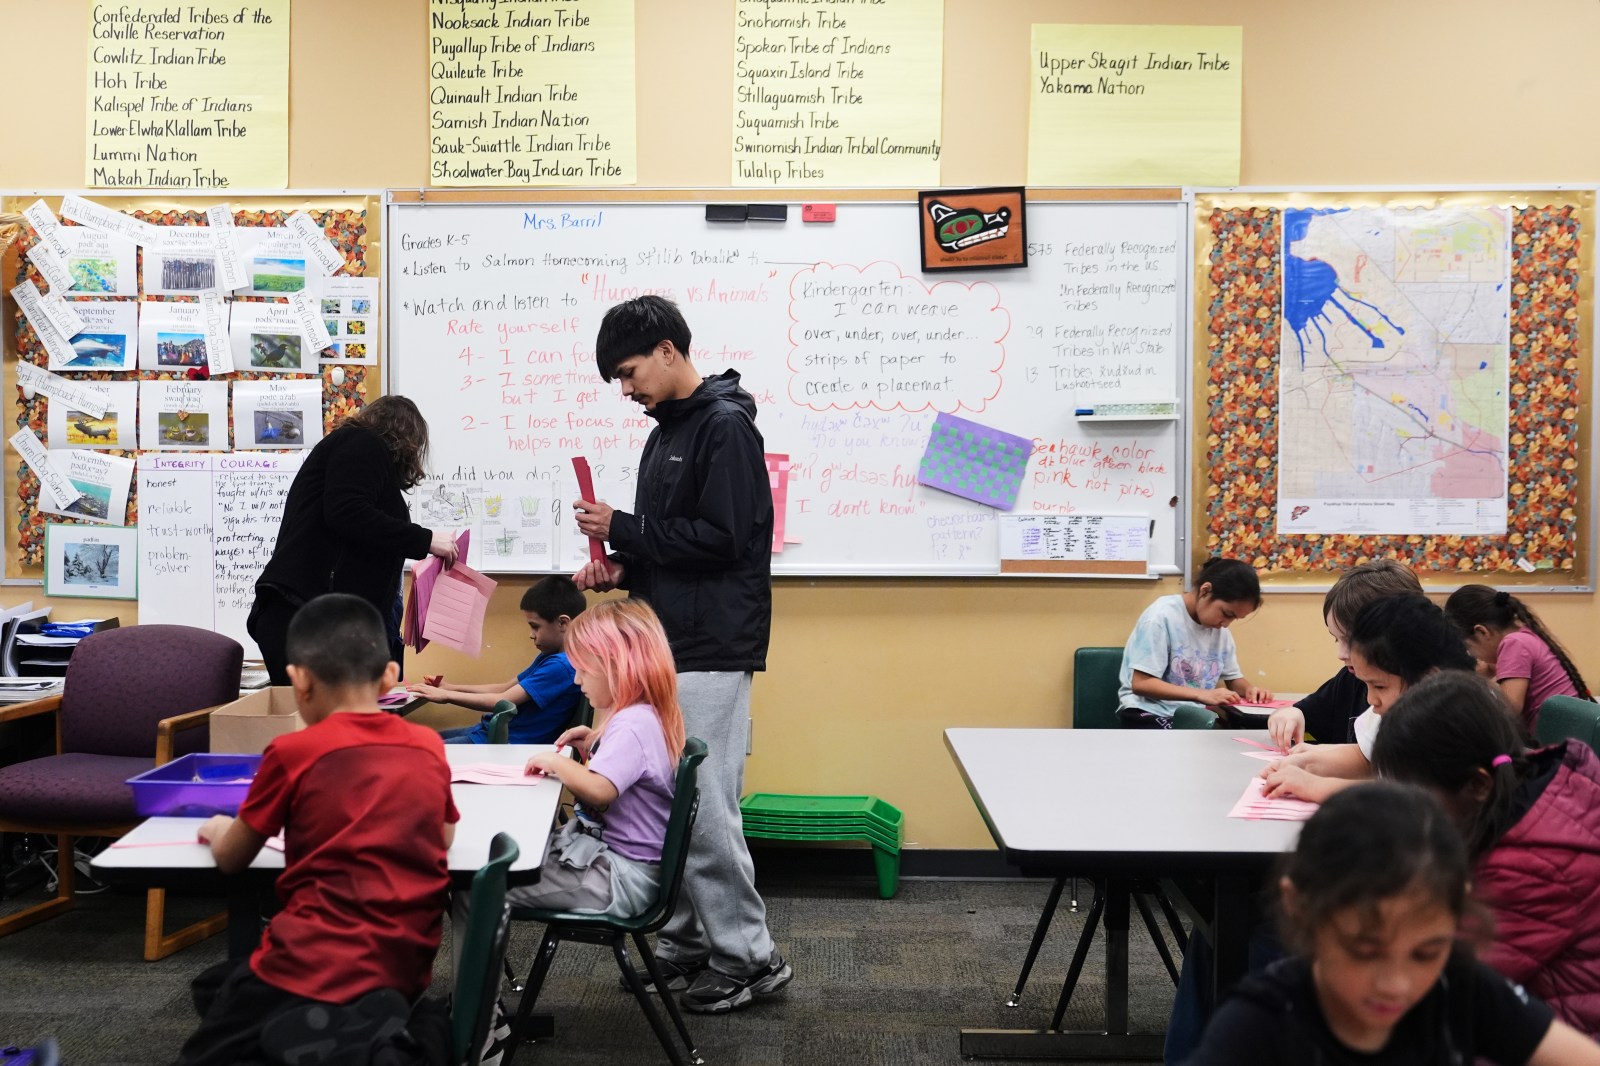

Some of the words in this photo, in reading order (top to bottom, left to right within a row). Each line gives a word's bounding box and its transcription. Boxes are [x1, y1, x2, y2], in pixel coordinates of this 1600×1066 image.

[94, 5, 180, 24] Confederated
[188, 7, 228, 24] Tribes
[233, 7, 248, 23] of
[252, 7, 272, 24] the
[433, 12, 499, 29] Nooksack
[504, 11, 551, 28] Indian
[555, 10, 590, 27] Tribe
[738, 11, 810, 28] Snohomish
[817, 11, 846, 28] Tribe
[93, 22, 138, 39] Colville
[144, 23, 225, 40] Reservation
[94, 46, 146, 64] Cowlitz
[149, 47, 194, 65] Indian
[195, 48, 226, 64] Tribe
[433, 37, 487, 61] Puyallup
[490, 36, 520, 53] Tribe
[525, 36, 539, 51] of
[542, 35, 595, 52] Indians
[737, 36, 786, 60] Spokan
[789, 36, 819, 54] Tribe
[823, 37, 839, 54] of
[841, 36, 891, 54] Indians
[431, 62, 486, 79] Quileute
[492, 60, 523, 77] Tribe
[737, 61, 788, 84] Squaxin
[790, 61, 831, 79] Island
[837, 61, 864, 79] Tribe
[1040, 51, 1085, 76] Upper
[1089, 51, 1138, 76] Skagit
[1144, 53, 1192, 70] Indian
[1197, 53, 1230, 70] Tribe
[94, 71, 126, 89] Hoh
[133, 72, 167, 89] Tribe
[1040, 76, 1093, 94] Yakama
[1098, 77, 1145, 95] Nation
[431, 86, 491, 104] Quinault
[495, 85, 541, 103] Indian
[545, 84, 577, 101] Tribe
[738, 85, 825, 110] Stillaguamish
[831, 87, 862, 104] Tribe
[94, 96, 144, 117] Kalispel
[150, 96, 178, 112] Tribe
[182, 98, 197, 111] of
[201, 97, 252, 112] Indians
[214, 119, 246, 137] Tribe
[432, 111, 486, 129] Samish
[492, 111, 538, 128] Indian
[541, 110, 589, 127] Nation
[737, 110, 804, 135] Suquamish
[809, 111, 839, 129] Tribe
[432, 136, 521, 153] Sauk-Suiattle
[526, 134, 573, 152] Indian
[576, 133, 611, 151] Tribe
[735, 136, 801, 154] Swinomish
[804, 137, 842, 154] Indian
[845, 137, 879, 154] Tribal
[881, 137, 941, 161] Community
[93, 144, 141, 161] Lummi
[147, 144, 197, 162] Nation
[94, 167, 142, 186] Makah
[147, 168, 190, 186] Indian
[193, 168, 229, 187] Tribe
[432, 161, 503, 178] Shoalwater
[504, 160, 530, 183] Bay
[532, 159, 583, 177] Indian
[586, 158, 621, 176] Tribe
[736, 160, 781, 184] Tulalip
[785, 161, 824, 178] Tribes
[523, 213, 556, 230] Mrs.
[561, 212, 602, 228] Barril
[80, 232, 108, 240] August
[170, 230, 209, 238] December
[402, 233, 441, 251] Grades
[1065, 243, 1115, 261] Federally
[455, 257, 470, 271] to
[482, 255, 534, 268] Salmon
[542, 253, 628, 274] Homecoming
[1064, 262, 1098, 275] Tribes
[1105, 262, 1117, 272] in
[1120, 260, 1139, 271] the
[168, 306, 199, 316] January
[472, 294, 507, 312] and
[514, 295, 550, 309] listen
[561, 293, 578, 306] to
[834, 303, 846, 317] I
[862, 303, 898, 314] can
[908, 304, 959, 316] weave
[73, 307, 115, 317] September
[267, 308, 288, 316] April
[447, 319, 485, 336] Rate
[498, 317, 580, 344] yourself
[846, 328, 883, 343] under,
[891, 331, 920, 343] over,
[499, 349, 515, 365] I
[527, 350, 562, 364] can
[717, 345, 757, 361] time
[805, 354, 848, 370] strips
[855, 351, 871, 365] of
[881, 354, 925, 373] paper
[940, 352, 956, 365] to
[499, 373, 518, 388] I
[806, 378, 854, 396] create
[861, 381, 869, 390] a
[166, 385, 201, 395] February
[502, 389, 538, 405] but
[553, 389, 567, 402] I
[576, 390, 601, 409] get
[501, 415, 517, 430] I
[529, 414, 557, 429] lose
[567, 413, 613, 430] focus
[623, 413, 649, 429] and
[508, 434, 551, 455] helps
[559, 437, 583, 449] me
[593, 435, 621, 459] get
[1111, 440, 1156, 459] color
[71, 452, 112, 468] November
[153, 458, 205, 468] INTEGRITY
[221, 459, 278, 468] COURAGE
[1060, 454, 1085, 467] blue
[147, 479, 177, 488] honest
[1034, 468, 1076, 489] pink
[1086, 478, 1112, 491] not
[217, 533, 265, 544] protecting
[154, 562, 190, 575] solver
